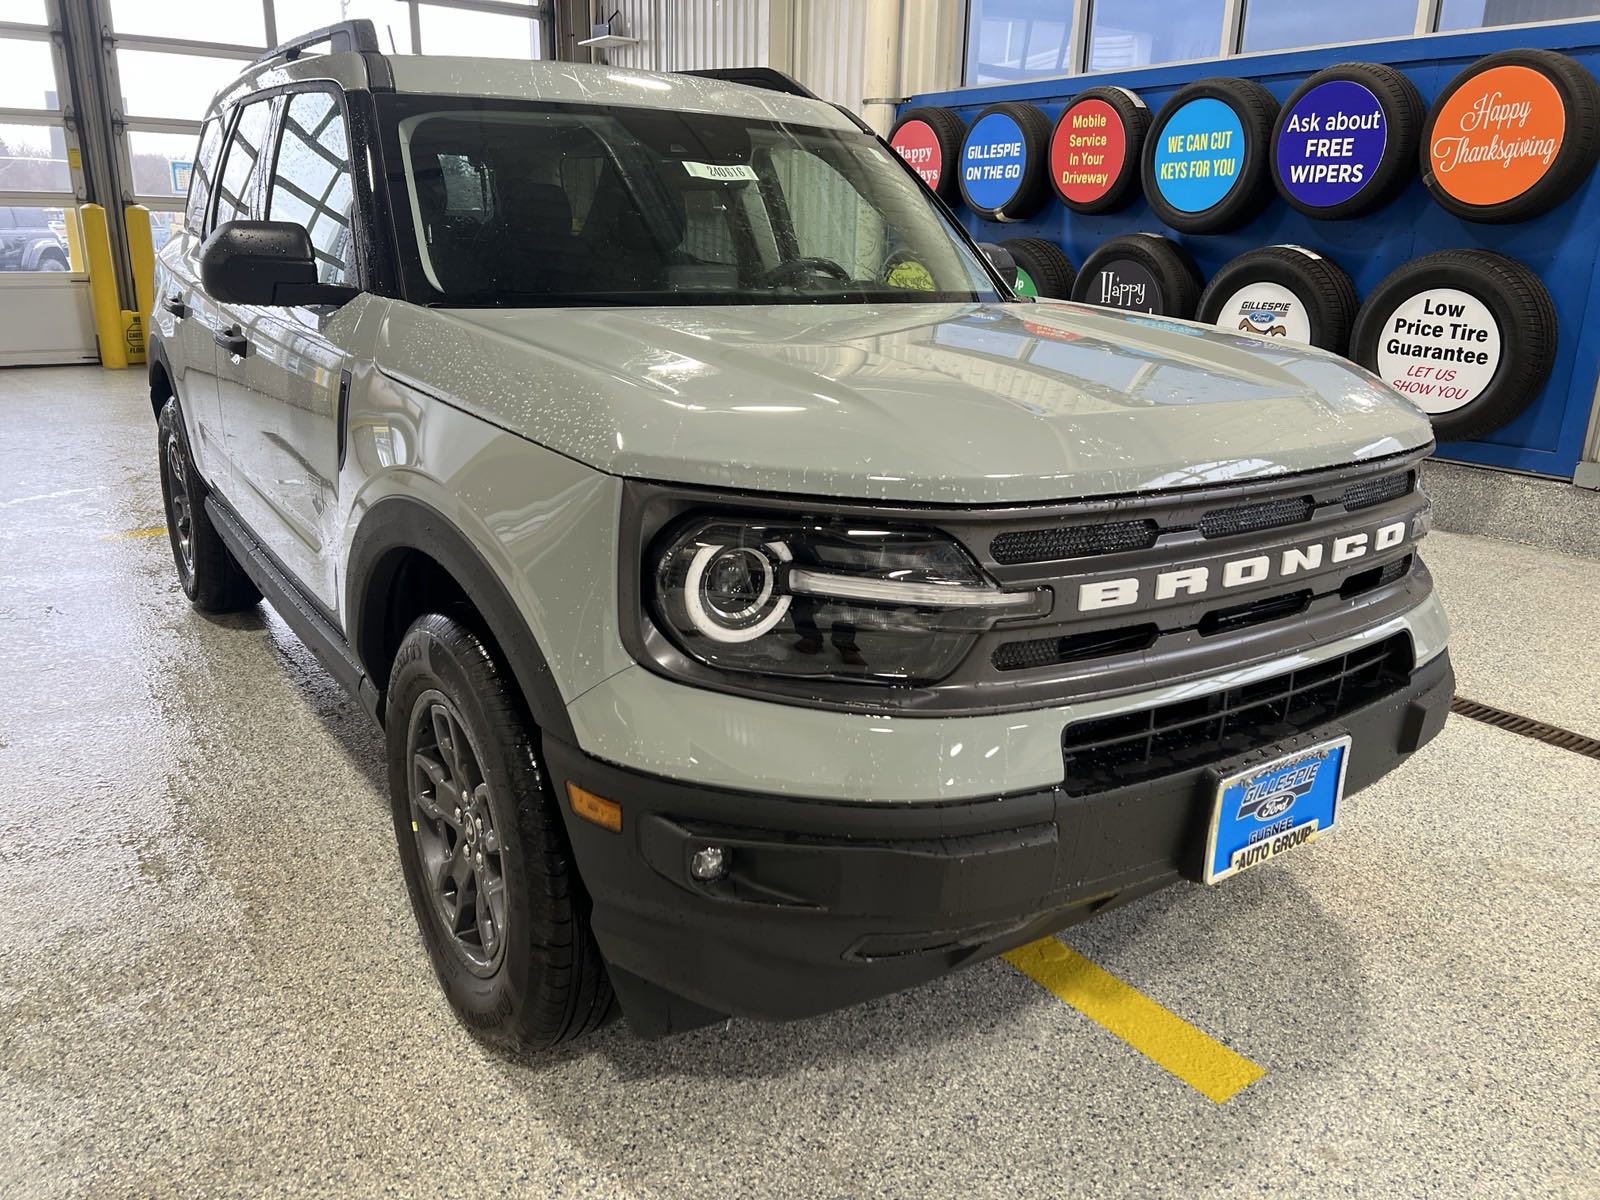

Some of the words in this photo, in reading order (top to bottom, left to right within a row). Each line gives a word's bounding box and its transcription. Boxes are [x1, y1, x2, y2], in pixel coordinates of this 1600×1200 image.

[1072, 114, 1107, 129] Mobile
[1287, 112, 1320, 133] Ask
[1325, 110, 1381, 131] about
[1460, 91, 1532, 132] Happy
[1069, 133, 1107, 148] Service
[1168, 135, 1184, 153] WE
[1186, 133, 1208, 152] CAN
[1210, 130, 1233, 150] CUT
[1305, 138, 1355, 157] FREE
[895, 145, 932, 163] Happy
[967, 142, 1022, 160] GILLESPIE
[1069, 153, 1079, 166] In
[1082, 152, 1105, 166] Your
[1433, 134, 1557, 173] Thanksgiving
[966, 166, 981, 180] ON
[983, 165, 1004, 180] THE
[1004, 164, 1021, 179] GO
[1062, 171, 1108, 187] Driveway
[1160, 161, 1188, 180] KEYS
[1189, 160, 1210, 178] FOR
[1213, 158, 1236, 177] YOU
[1290, 163, 1364, 183] WIPERS
[1100, 271, 1146, 306] Happy
[1241, 301, 1291, 311] GILLESPIE
[1423, 298, 1466, 318] Low
[1394, 317, 1444, 338] Price
[1449, 323, 1488, 342] Tire
[1386, 338, 1489, 365] Guarantee
[1406, 365, 1434, 378] LET
[1435, 369, 1457, 381] US
[1392, 380, 1436, 395] SHOW
[1437, 385, 1469, 400] YOU
[1078, 521, 1405, 612] BRONCO
[1242, 761, 1322, 806] GILLESPIE
[1261, 797, 1289, 817] Ford
[1249, 816, 1294, 845] GURNEE
